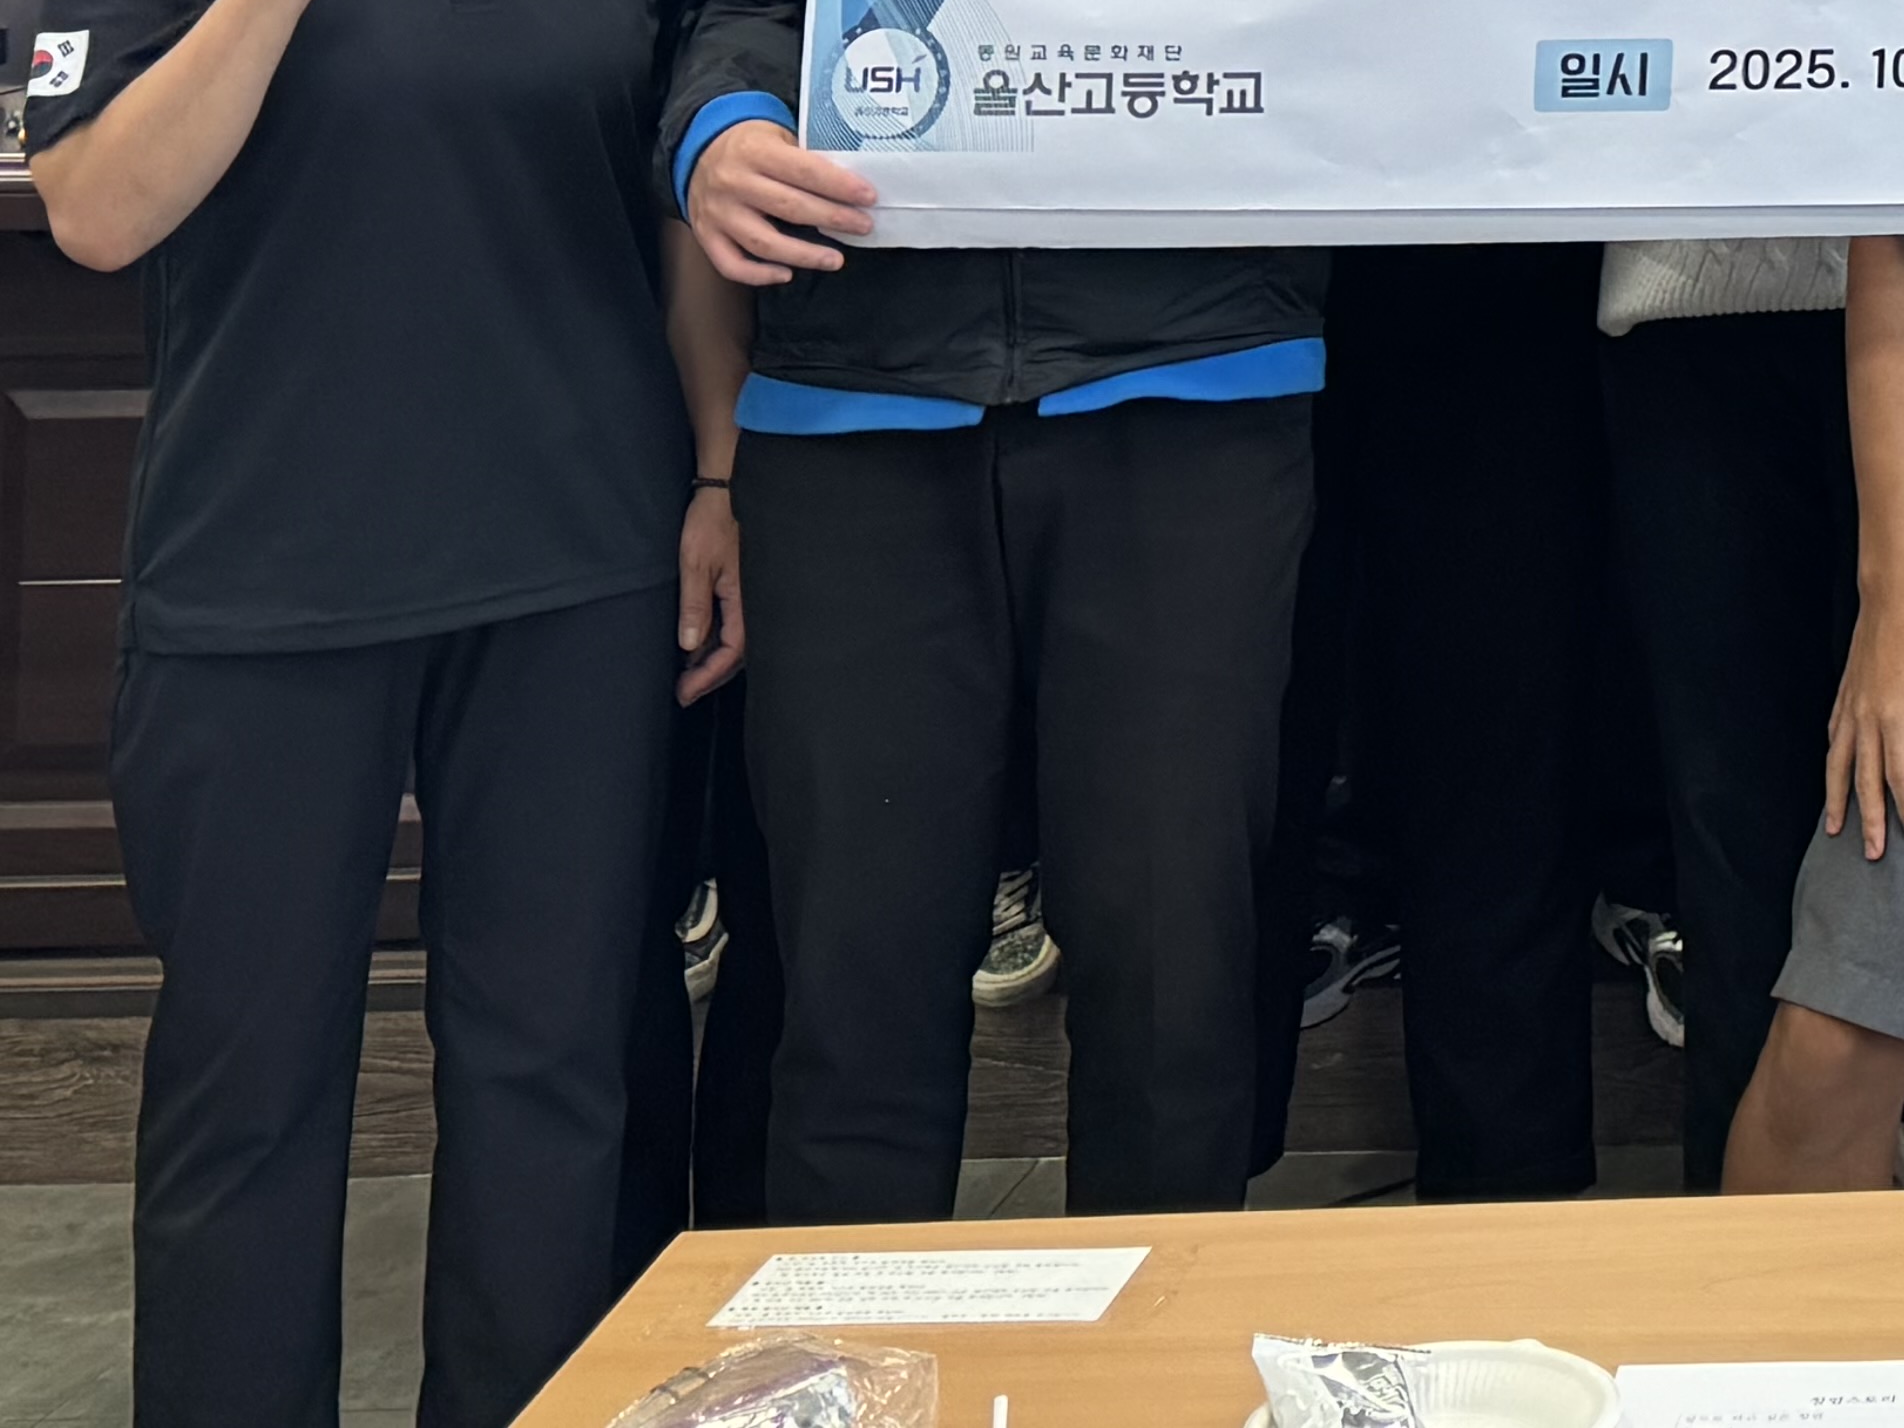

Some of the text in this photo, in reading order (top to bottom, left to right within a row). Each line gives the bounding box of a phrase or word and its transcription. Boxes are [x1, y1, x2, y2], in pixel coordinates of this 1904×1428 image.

[844, 54, 927, 94] USH
[1559, 53, 1650, 100] 일시
[1708, 47, 1852, 93] 2025.
[973, 68, 1265, 119] 울산고등학교
